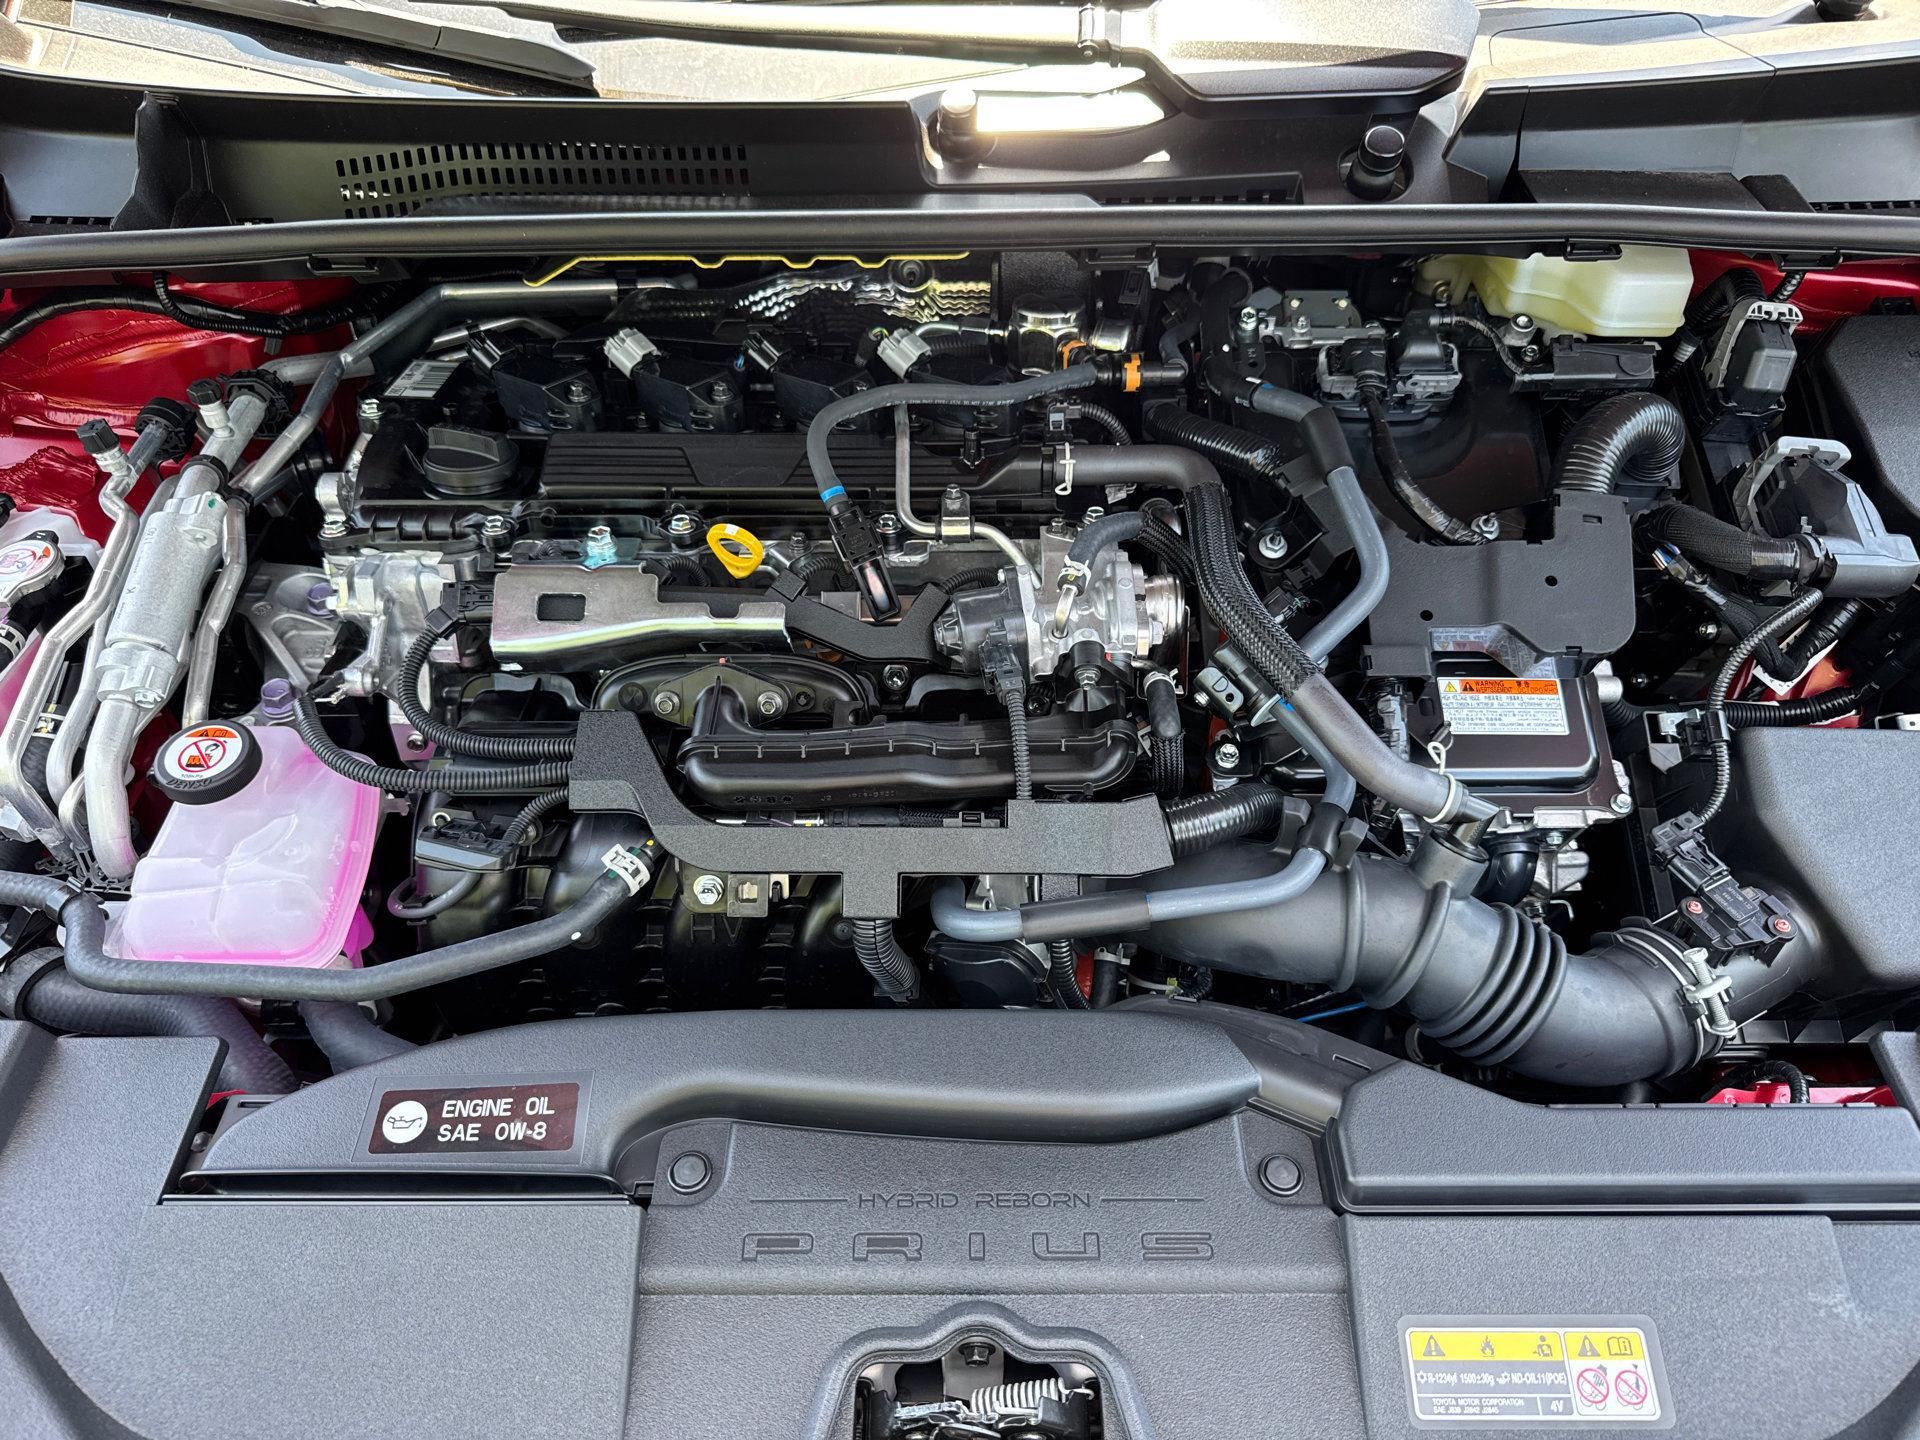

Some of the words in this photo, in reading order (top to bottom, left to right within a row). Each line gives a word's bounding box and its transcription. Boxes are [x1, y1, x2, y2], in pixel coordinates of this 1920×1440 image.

[166, 778, 213, 790] DENSO
[441, 1098, 514, 1118] ENGINE
[525, 1096, 556, 1116] OIL
[437, 1123, 482, 1142] SAE
[494, 1121, 548, 1142] 0W-8
[858, 1192, 959, 1208] HYBRID
[975, 1192, 1091, 1208] REBORN
[741, 1231, 1214, 1262] PRIUS
[1432, 1398, 1456, 1406] TOYOTA
[1458, 1398, 1480, 1406] MOTOR
[1481, 1398, 1525, 1406] CORPORATION
[1550, 1400, 1564, 1413] 4V
[1433, 1406, 1446, 1414] SAE
